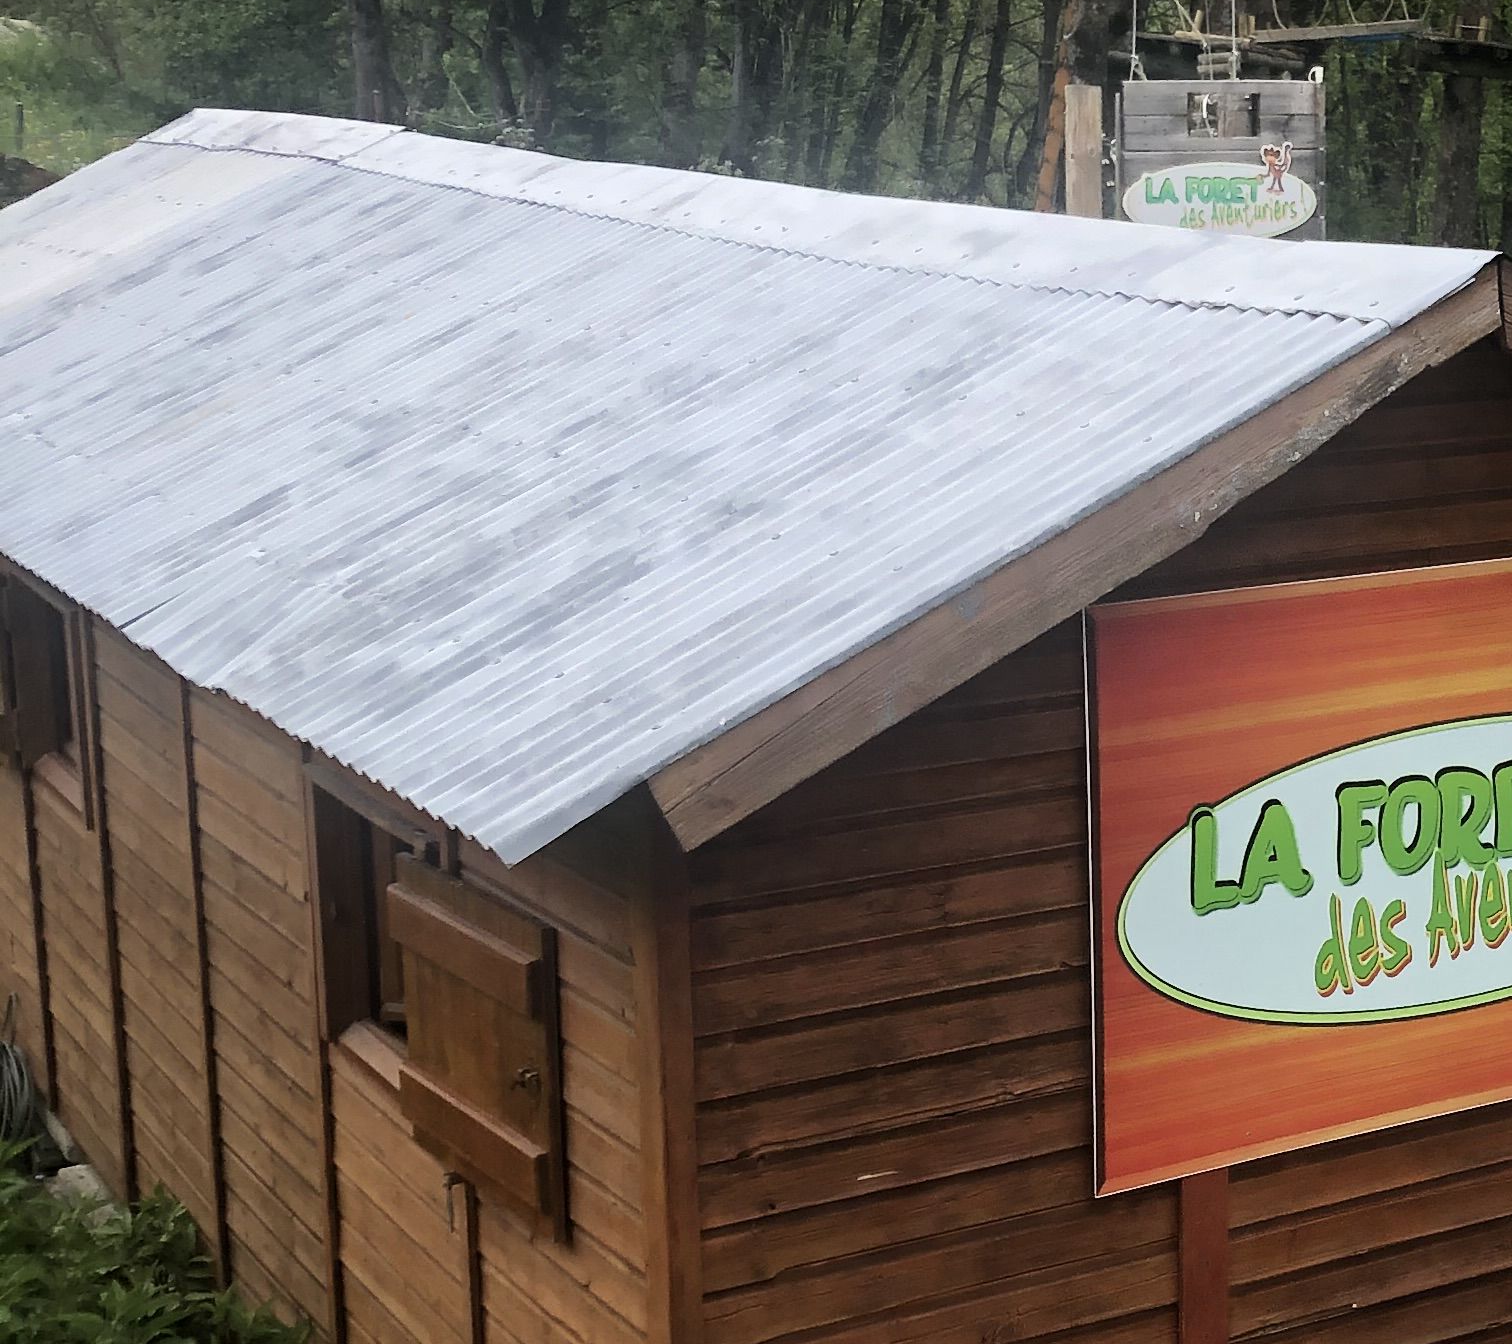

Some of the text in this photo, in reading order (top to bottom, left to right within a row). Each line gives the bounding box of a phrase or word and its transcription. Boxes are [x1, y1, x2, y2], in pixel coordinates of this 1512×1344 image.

[1145, 176, 1261, 205] LA FORET
[1180, 207, 1206, 229] des
[1189, 799, 1314, 916] LA
[1314, 893, 1412, 996] des
